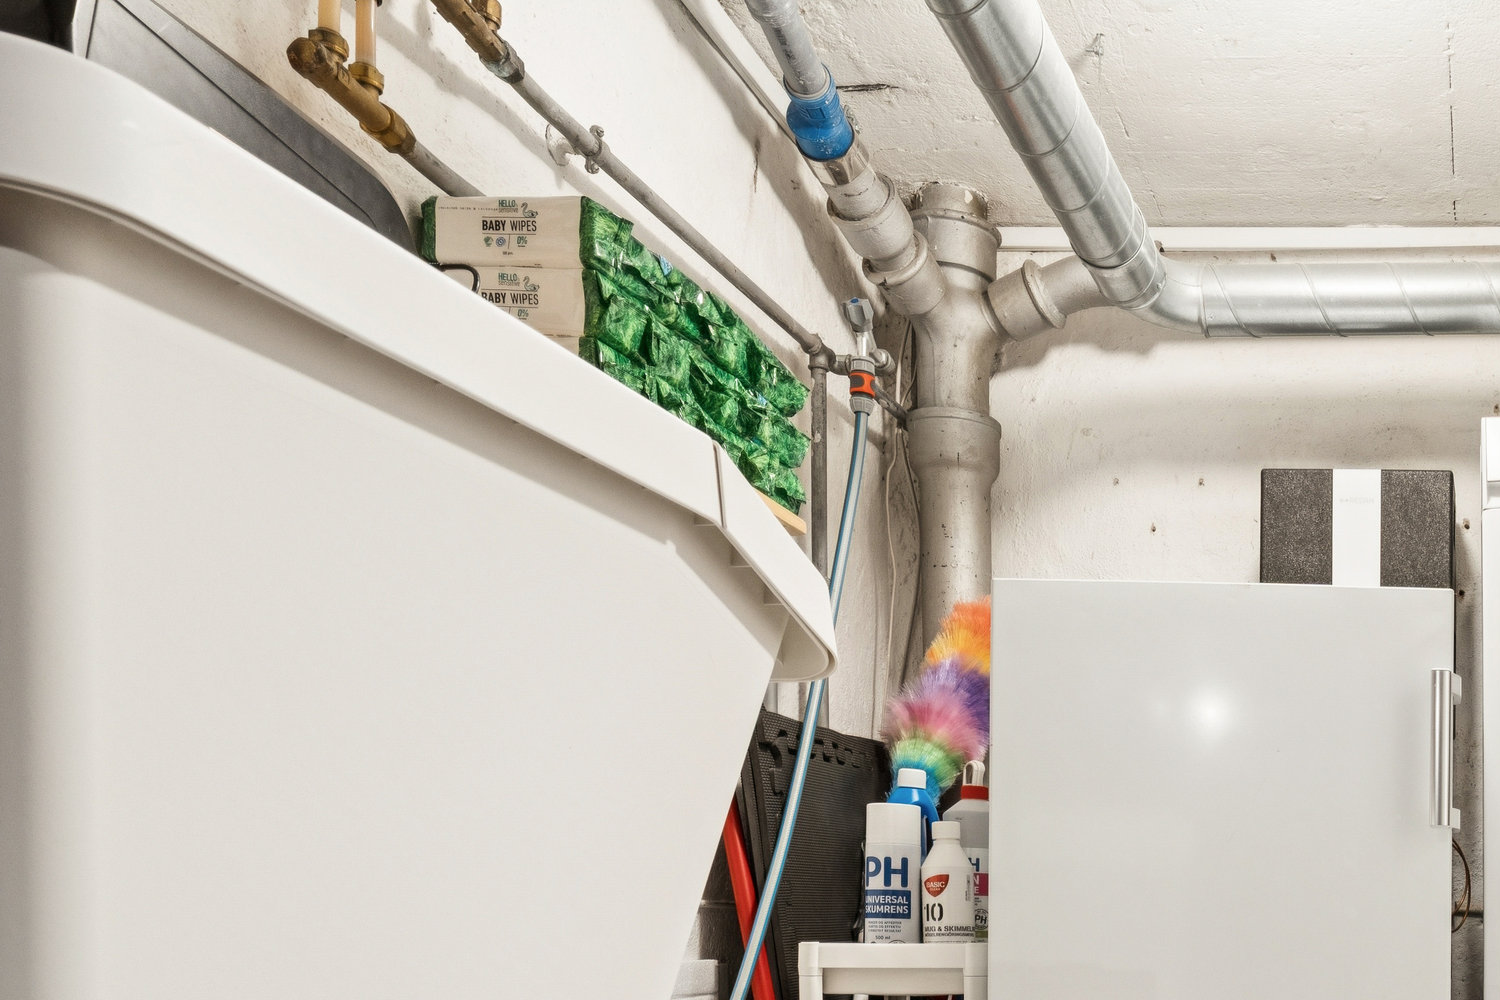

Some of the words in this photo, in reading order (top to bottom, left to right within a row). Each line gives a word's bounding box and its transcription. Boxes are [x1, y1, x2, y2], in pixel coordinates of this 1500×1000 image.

[498, 200, 516, 208] HELLO
[482, 220, 506, 231] BABY
[510, 220, 537, 232] WIPES
[516, 236, 528, 244] 0%
[498, 273, 517, 281] HELLO
[510, 294, 539, 305] WIPES
[866, 856, 908, 888] PH
[866, 904, 908, 914] SKUMRENS
